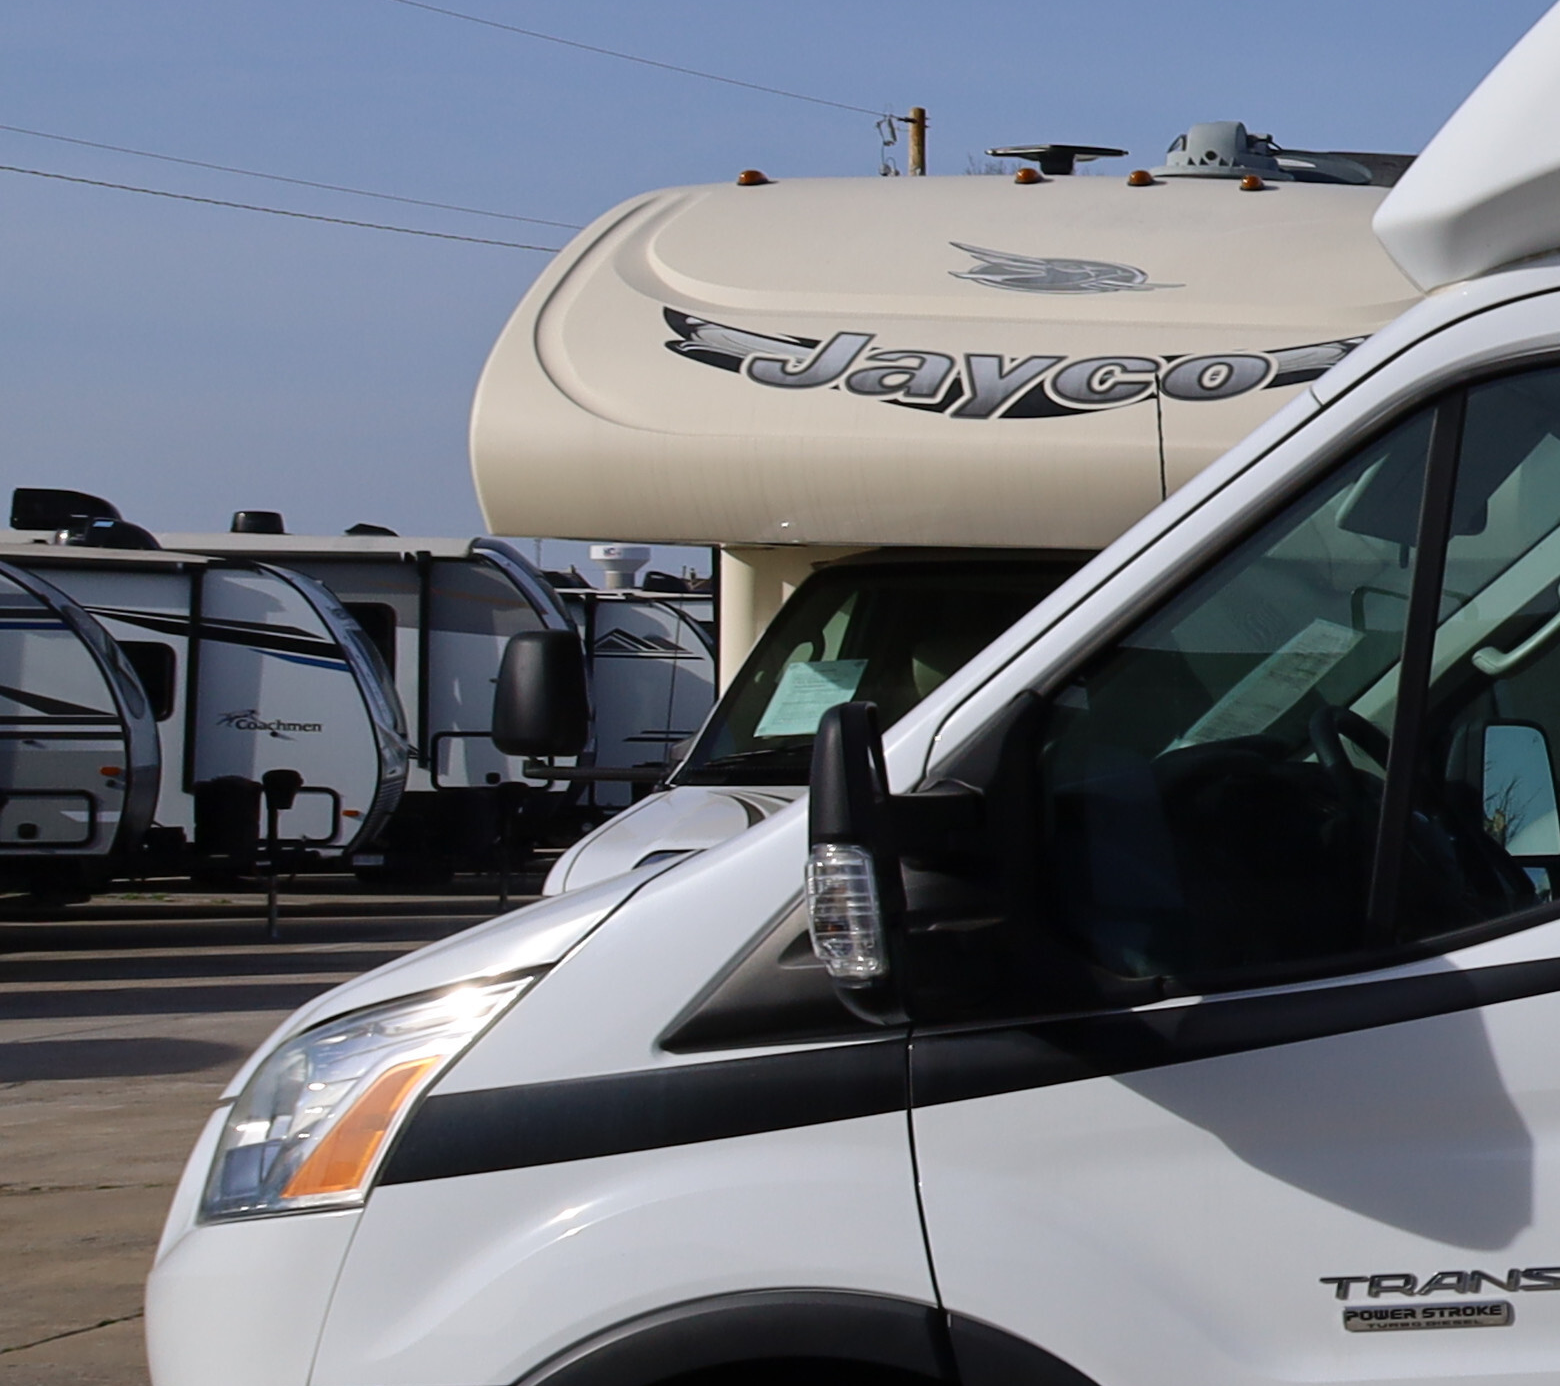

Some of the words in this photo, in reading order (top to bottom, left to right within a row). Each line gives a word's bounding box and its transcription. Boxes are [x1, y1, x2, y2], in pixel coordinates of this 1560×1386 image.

[745, 330, 1273, 420] Jayco
[235, 718, 322, 732] Coachmen
[1345, 1308, 1417, 1322] POWER
[1422, 1305, 1503, 1319] STROKE
